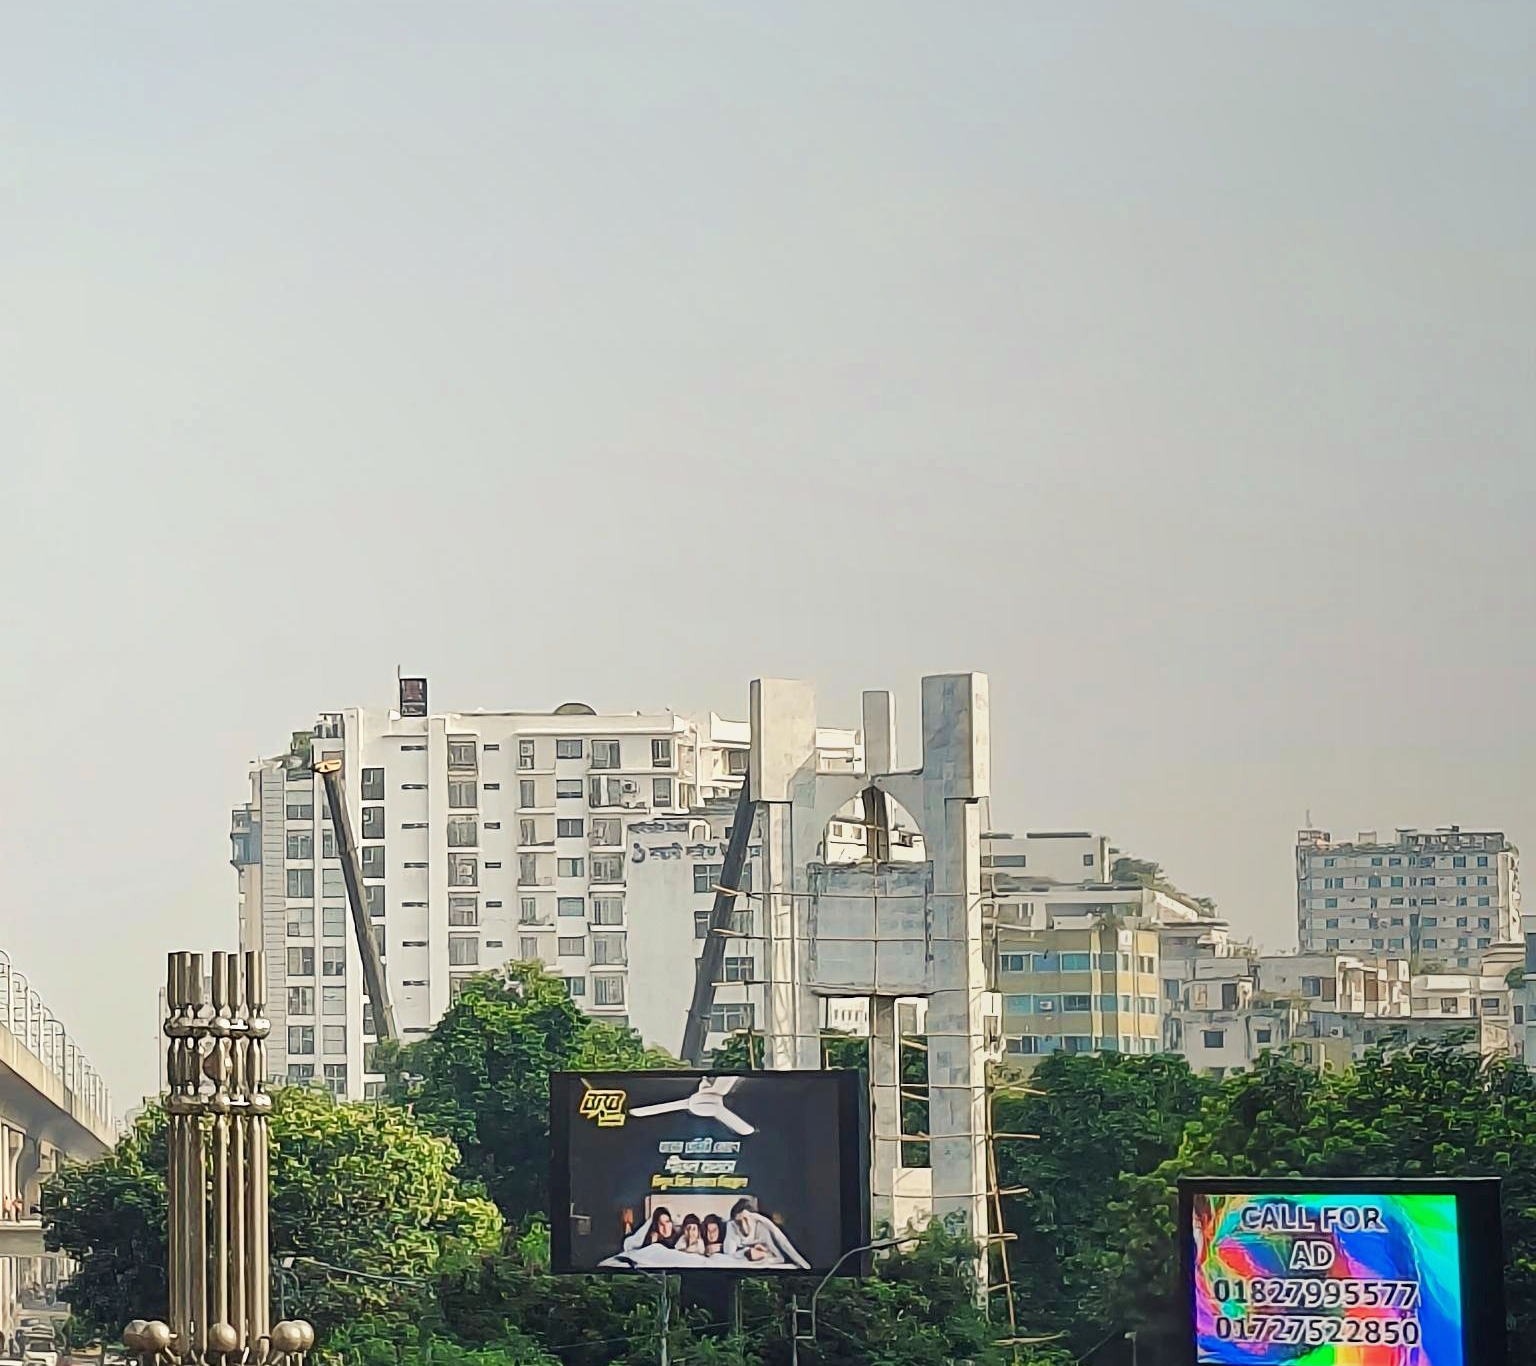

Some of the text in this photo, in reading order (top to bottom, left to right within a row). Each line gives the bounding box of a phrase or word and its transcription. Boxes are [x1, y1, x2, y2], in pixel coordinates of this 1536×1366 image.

[1241, 1205, 1387, 1233] CALL FOR
[1289, 1240, 1335, 1270] AD
[1214, 1278, 1420, 1307] 01827995577
[1216, 1317, 1420, 1347] 01727522850
